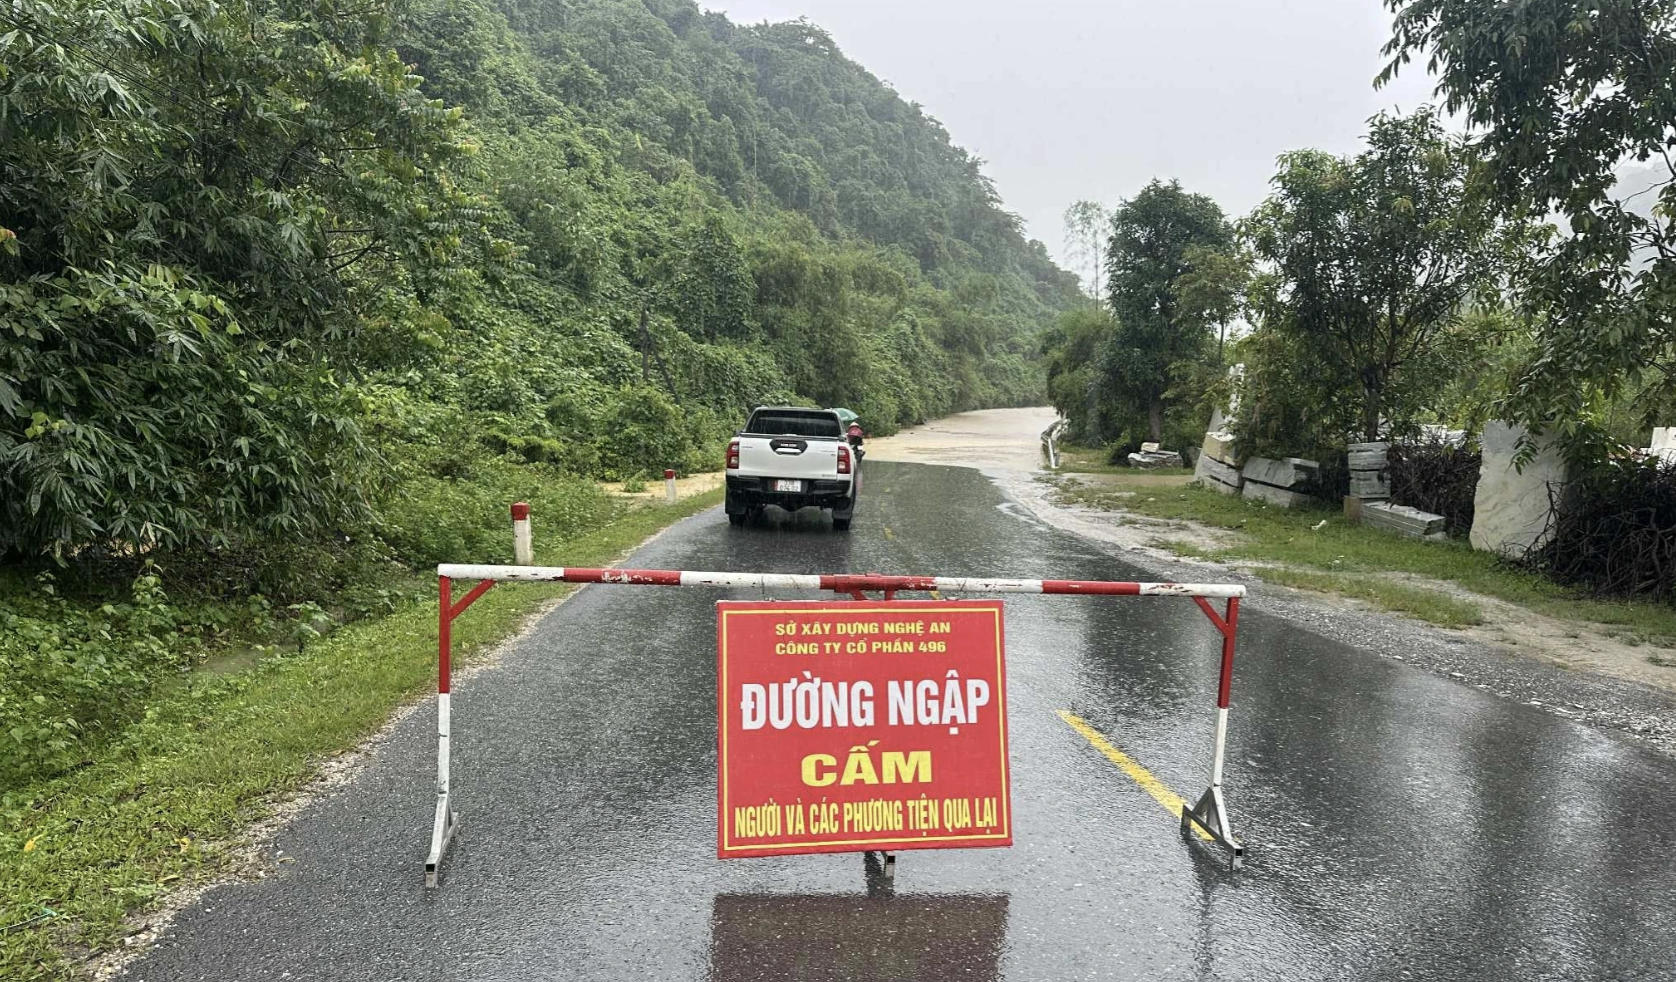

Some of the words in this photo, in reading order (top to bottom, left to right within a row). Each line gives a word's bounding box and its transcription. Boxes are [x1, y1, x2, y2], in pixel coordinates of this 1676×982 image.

[776, 620, 797, 635] SỞ
[802, 621, 830, 635] XÂY
[837, 622, 879, 637] DỰNG
[884, 620, 924, 636] NGHỆ
[930, 622, 950, 633] AN
[776, 641, 818, 655] CÔNG
[823, 642, 841, 654] TY
[846, 638, 867, 653] CỔ
[872, 638, 914, 653] PHẦN
[919, 641, 946, 652] 496
[741, 671, 874, 730] ĐƯỜNG
[888, 670, 989, 734] NGẬP
[801, 740, 932, 786] CẤM
[735, 798, 781, 838] NGƯỜI
[786, 798, 805, 835] VÀ
[810, 797, 839, 834] CÁC
[843, 798, 903, 832] PHƯƠNG
[907, 793, 939, 836] TIỆN
[943, 798, 971, 832] QUA
[975, 797, 998, 835] LẠI
